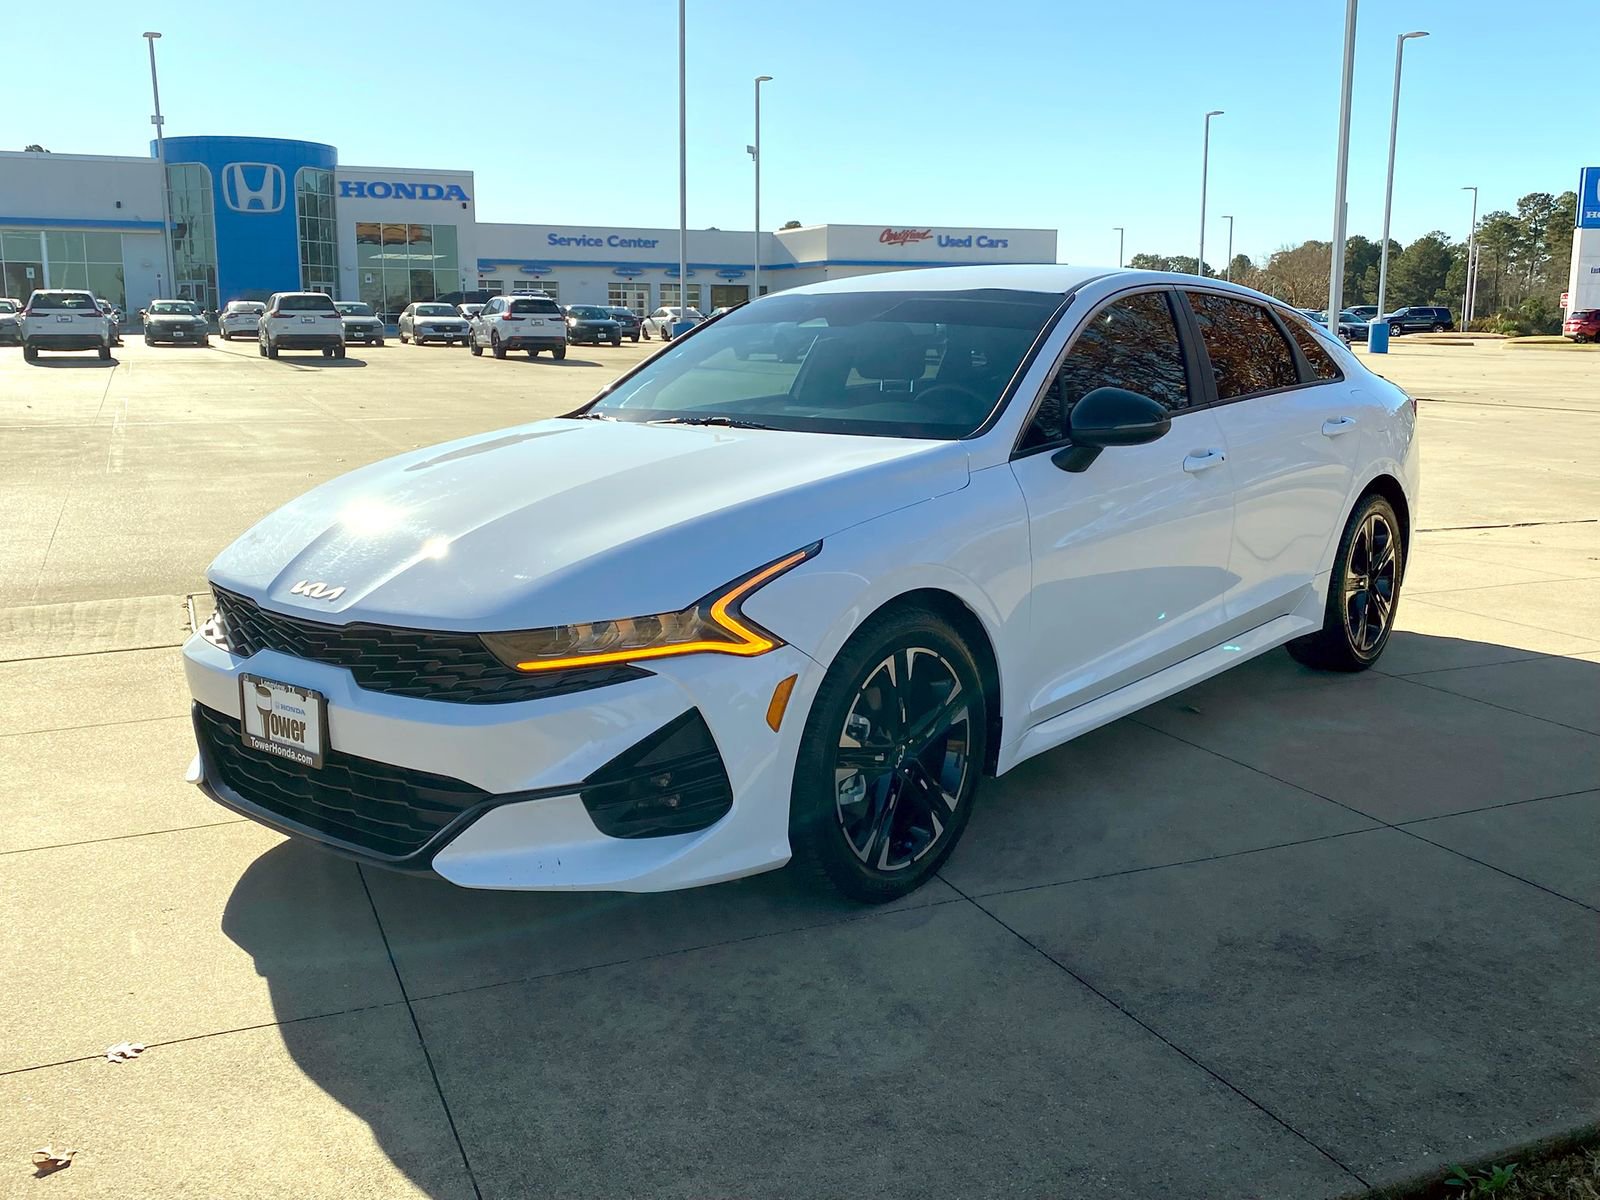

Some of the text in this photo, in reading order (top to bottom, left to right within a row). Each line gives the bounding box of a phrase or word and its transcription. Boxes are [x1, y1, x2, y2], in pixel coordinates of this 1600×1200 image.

[338, 181, 470, 201] HONDA
[547, 233, 659, 248] Service Center
[879, 228, 1008, 248] Certified Used Cars
[290, 579, 346, 602] KIA
[256, 686, 306, 744] Tower
[280, 703, 306, 716] HONDA
[250, 736, 314, 766] TowerHonda.com
